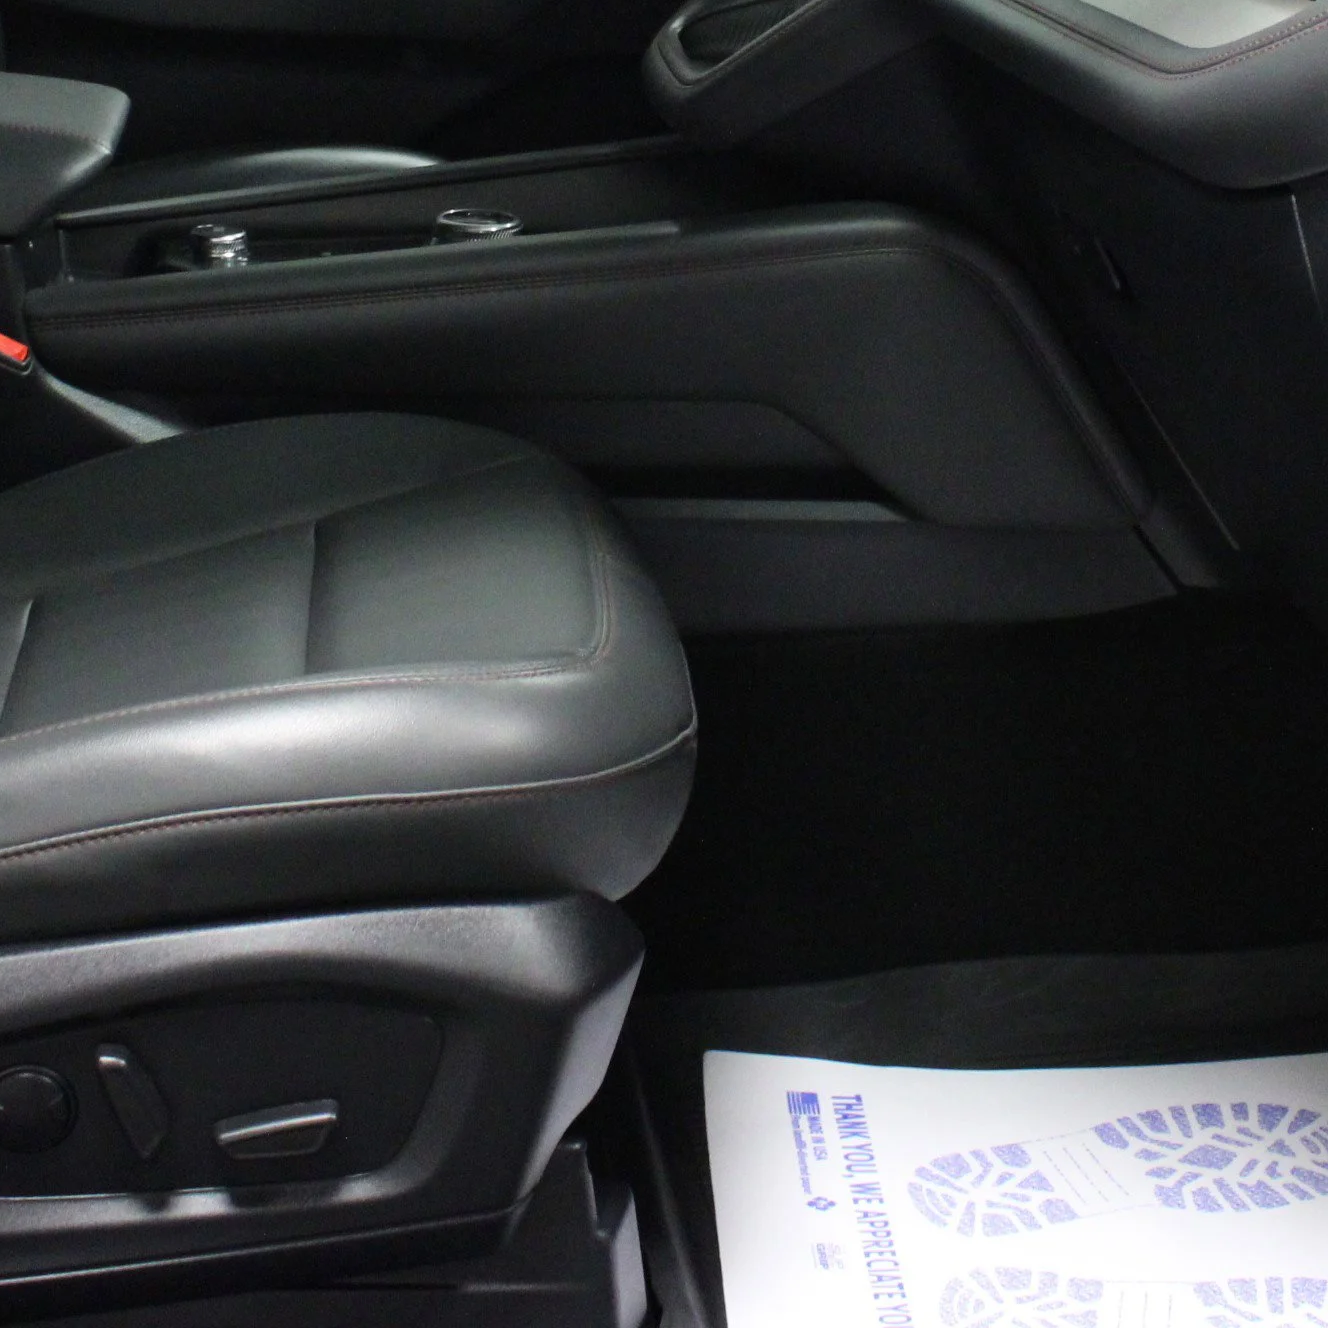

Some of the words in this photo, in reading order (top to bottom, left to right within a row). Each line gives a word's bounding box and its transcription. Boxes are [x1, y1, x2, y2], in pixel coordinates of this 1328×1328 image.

[807, 1115, 823, 1134] MADE
[831, 1094, 871, 1139] THANK
[813, 1146, 828, 1161] USA
[841, 1142, 878, 1178] YOU,
[849, 1181, 884, 1205] WE
[854, 1209, 907, 1300] APPRECIATE
[875, 1303, 915, 1328] YO
